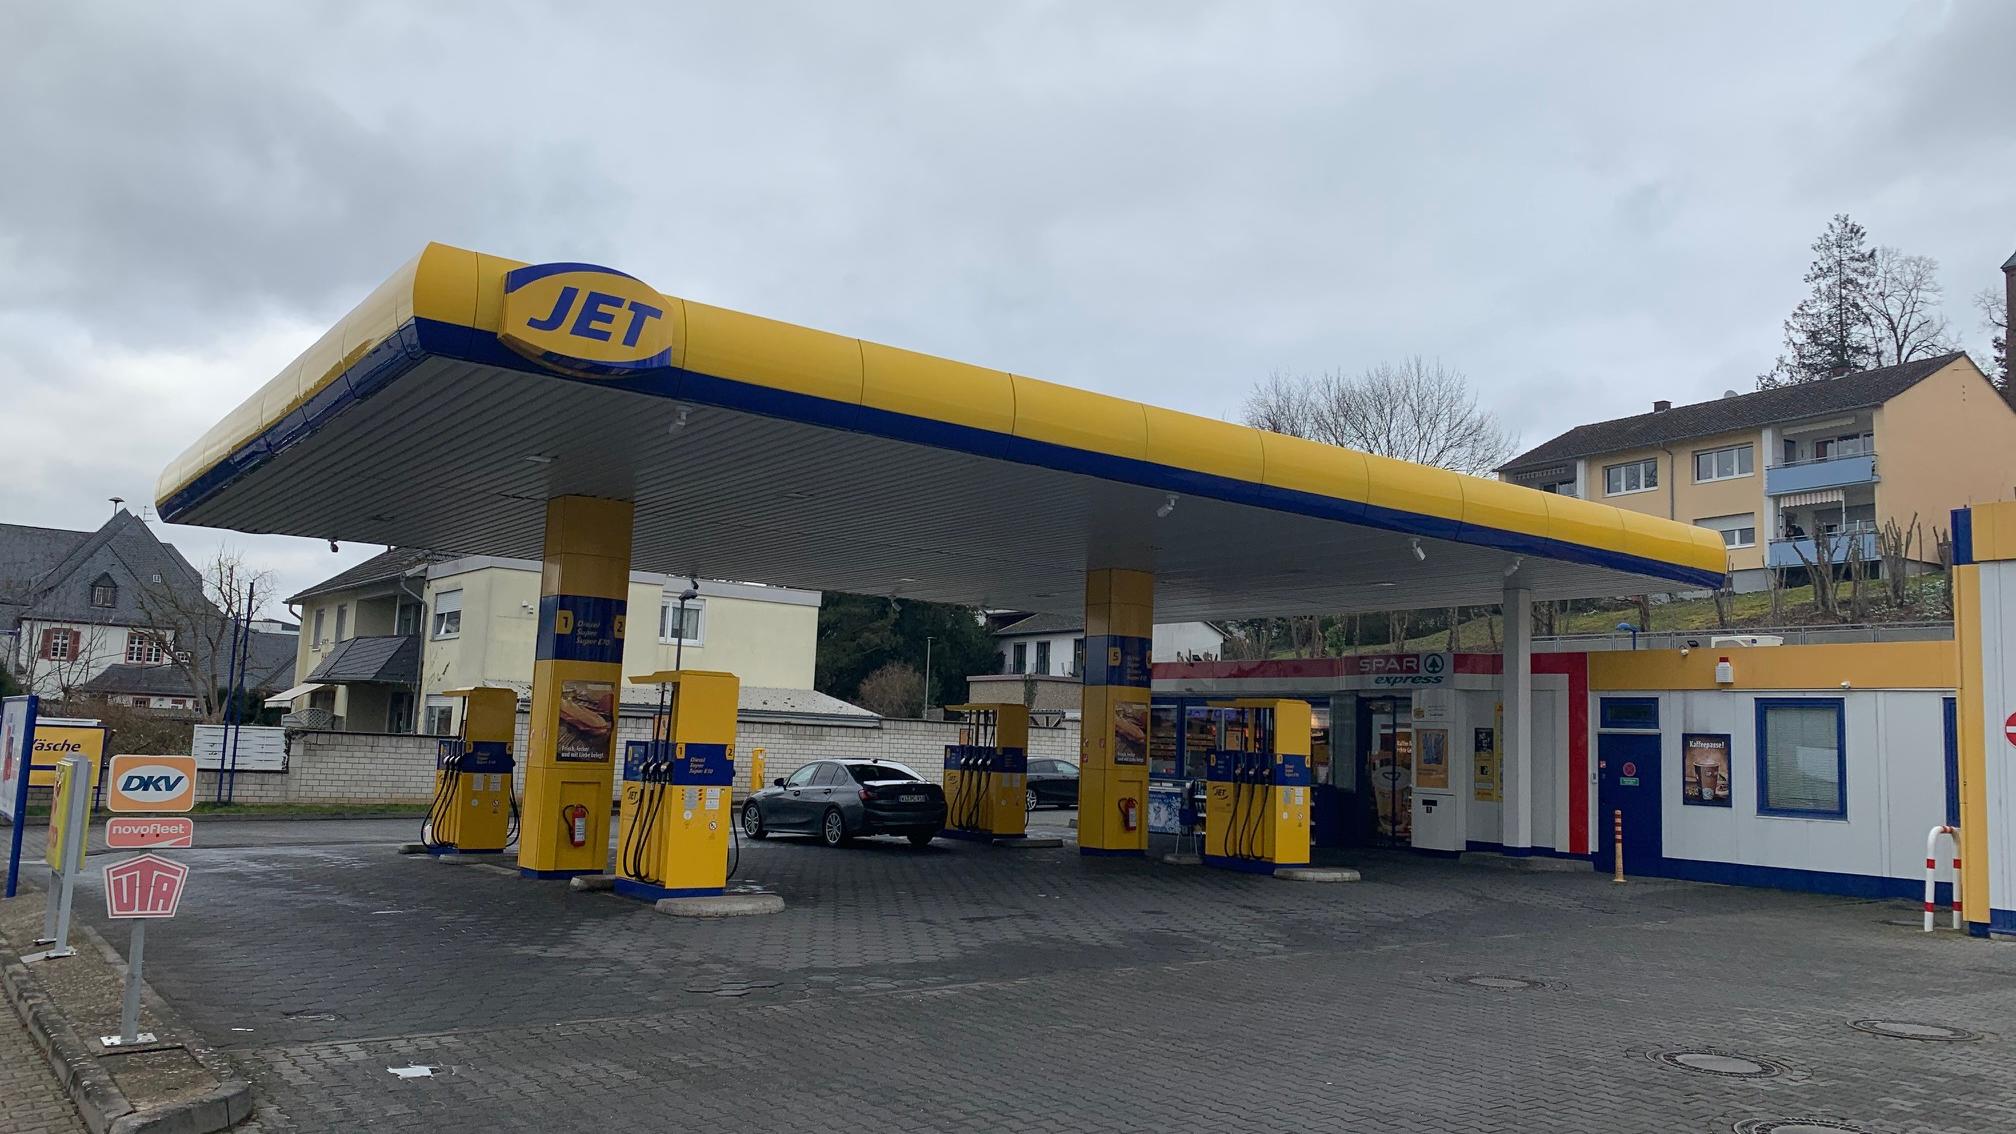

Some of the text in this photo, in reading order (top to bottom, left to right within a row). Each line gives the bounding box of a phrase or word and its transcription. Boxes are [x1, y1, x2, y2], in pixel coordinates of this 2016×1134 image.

[527, 286, 663, 348] JET
[616, 621, 623, 632] 2
[576, 628, 598, 638] Super
[576, 637, 597, 646] Super
[1113, 651, 1119, 661] 5
[1360, 657, 1418, 672] SPAR
[1374, 675, 1444, 687] express
[33, 738, 81, 752] äsche
[727, 748, 733, 756] 2
[121, 775, 185, 792] DKV
[628, 791, 638, 800] JET
[1214, 788, 1226, 796] JET
[112, 823, 185, 834] novofleet
[112, 860, 180, 912] UTA
